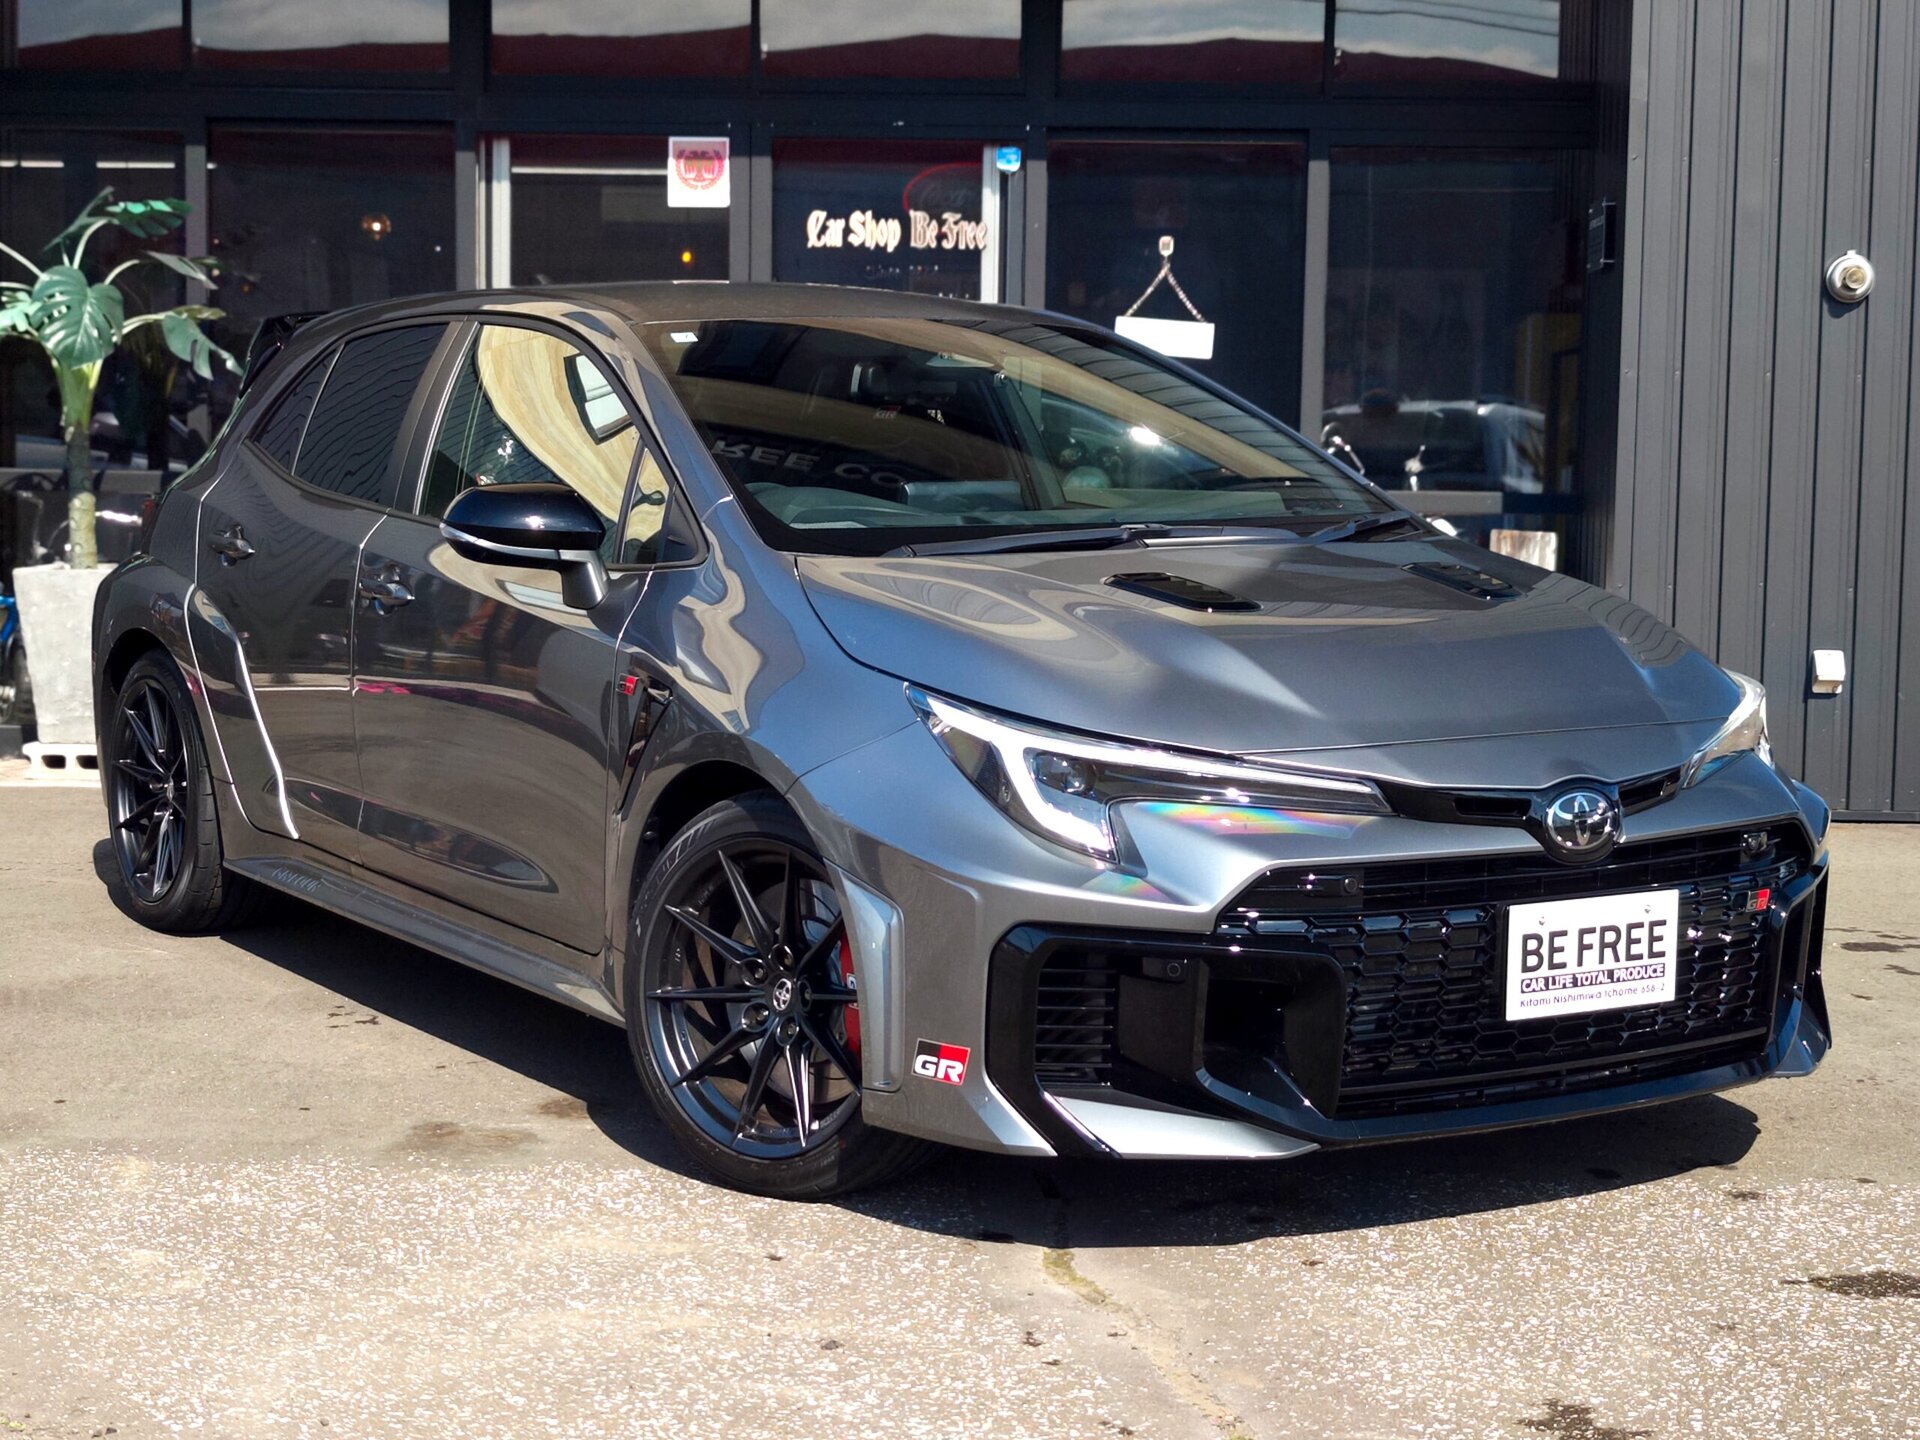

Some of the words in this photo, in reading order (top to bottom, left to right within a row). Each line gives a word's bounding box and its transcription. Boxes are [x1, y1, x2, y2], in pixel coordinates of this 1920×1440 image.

[807, 210, 845, 248] Car
[848, 210, 901, 253] Shop
[909, 209, 938, 249] Be
[941, 212, 987, 250] Free
[1521, 929, 1568, 974] BE
[1577, 919, 1667, 968] FREE
[1521, 978, 1547, 993] CAR
[1549, 974, 1574, 990] LIFE
[1576, 970, 1611, 986] TOTAL
[1613, 963, 1664, 982] PRODUCE
[1520, 998, 1551, 1008] Kitami
[1553, 990, 1602, 1004] Nishimiwa
[1604, 986, 1638, 998] Ichome
[914, 1054, 964, 1083] GR
